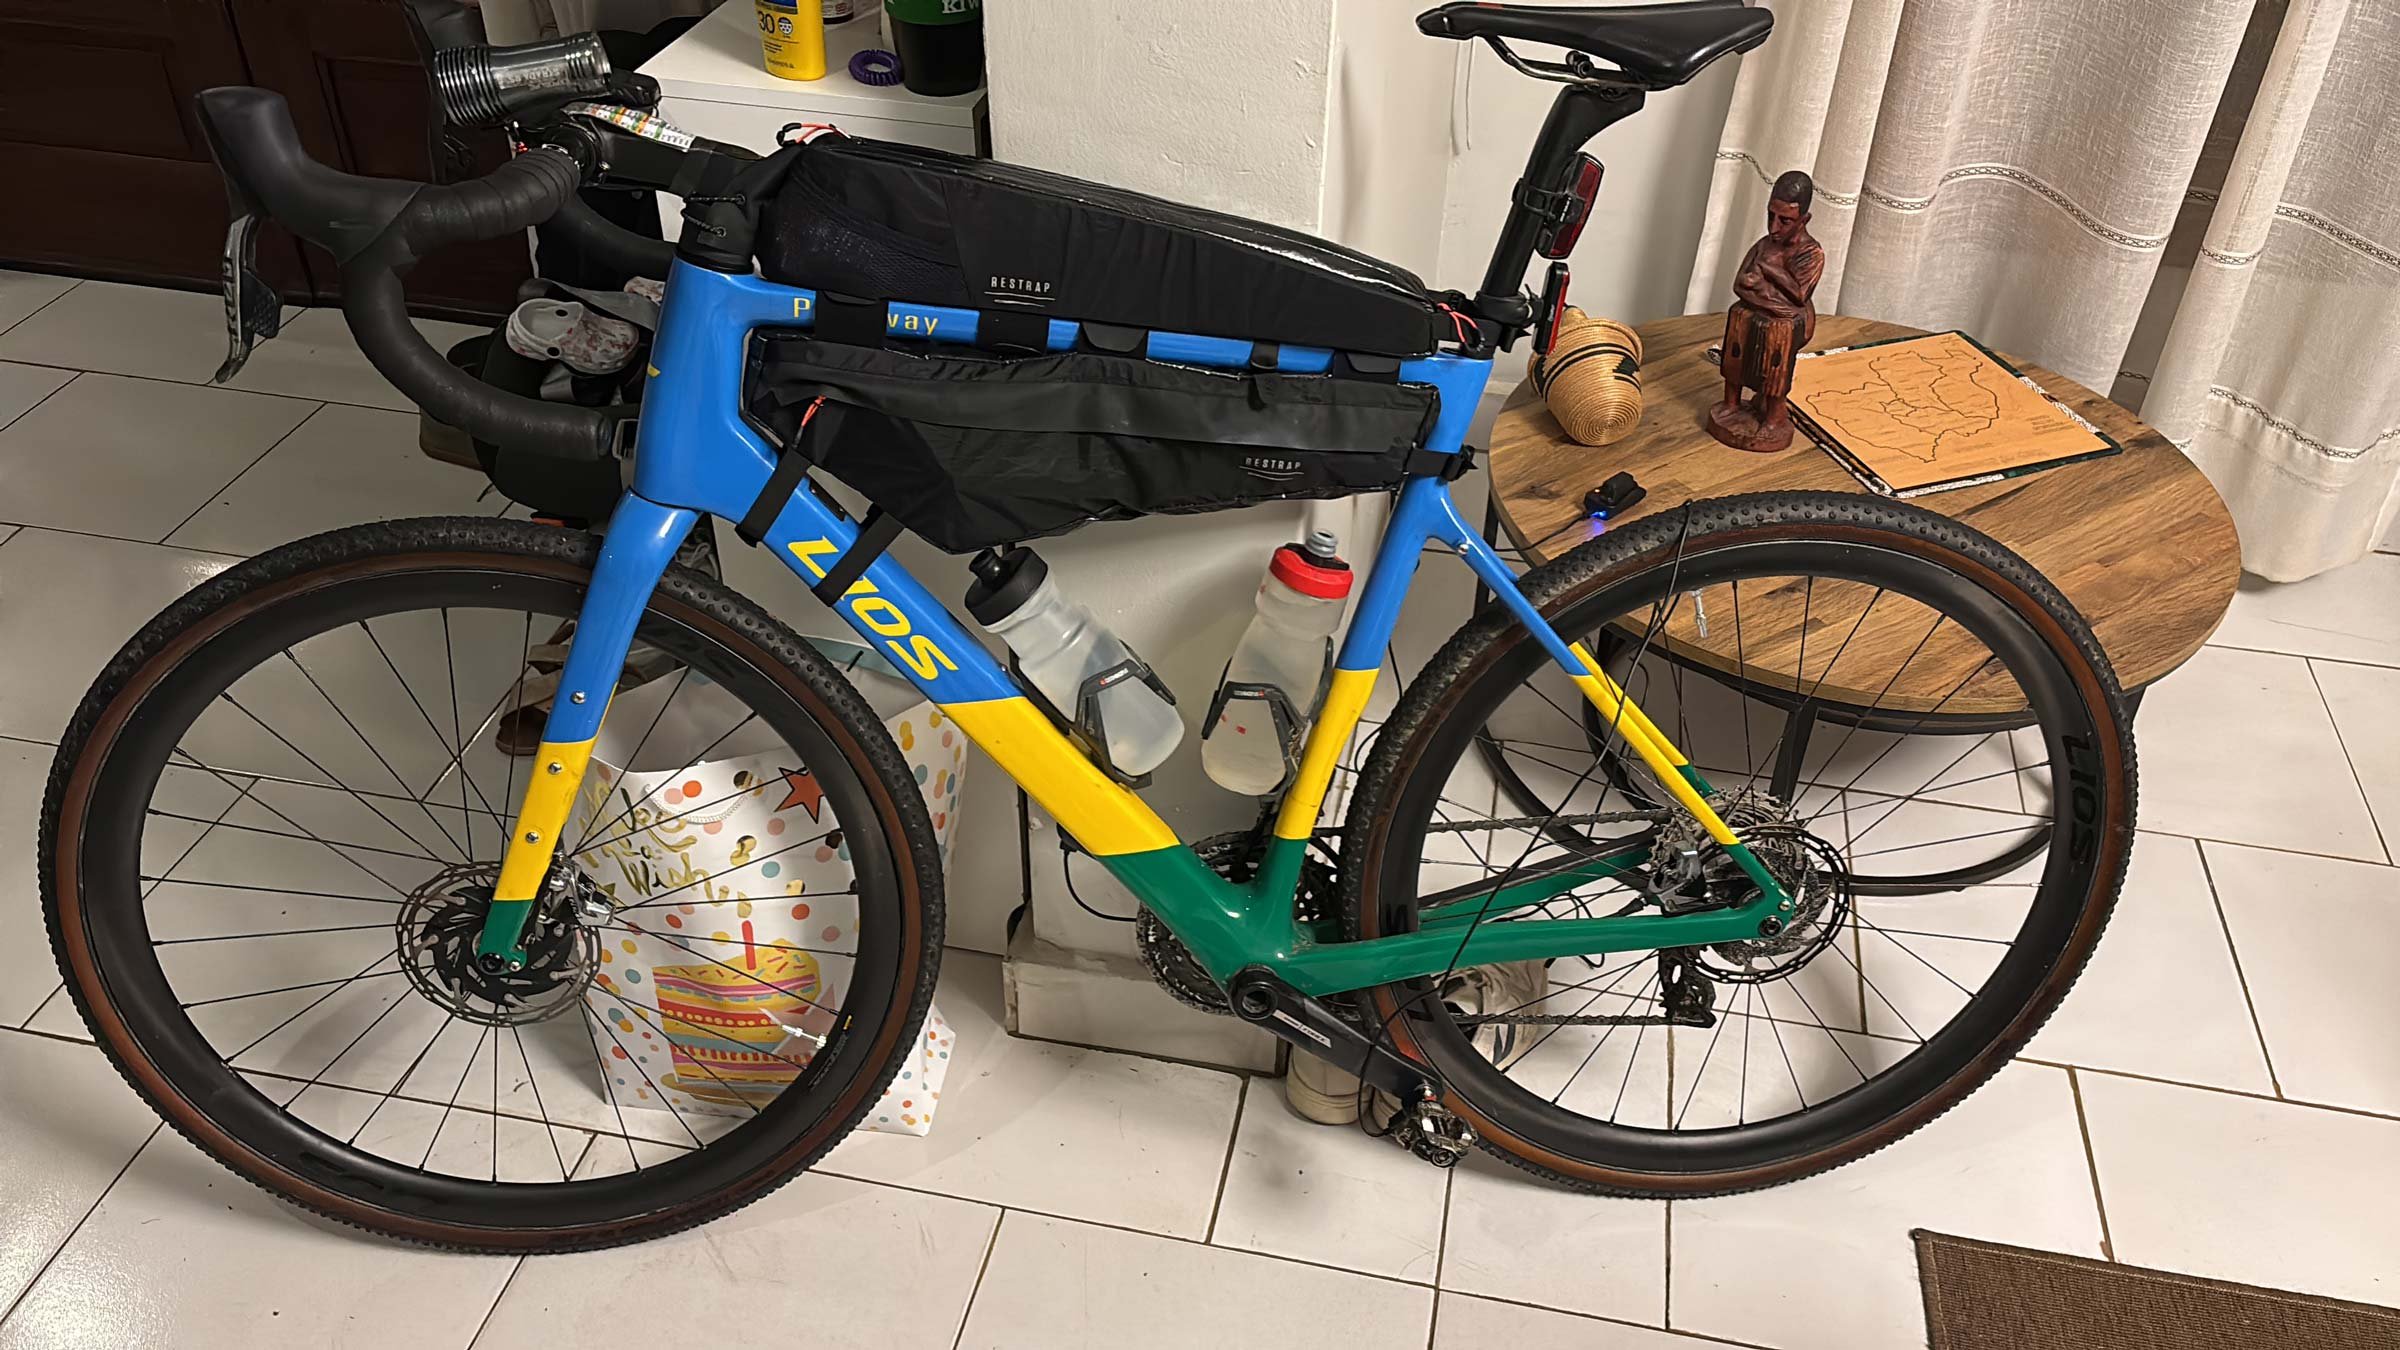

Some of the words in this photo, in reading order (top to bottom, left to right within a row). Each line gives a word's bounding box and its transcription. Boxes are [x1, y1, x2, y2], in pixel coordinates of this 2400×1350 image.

[757, 10, 775, 34] 30
[991, 276, 1051, 293] RESTRAP
[1245, 457, 1302, 470] RESTRAP
[2061, 735, 2098, 865] LIOS
